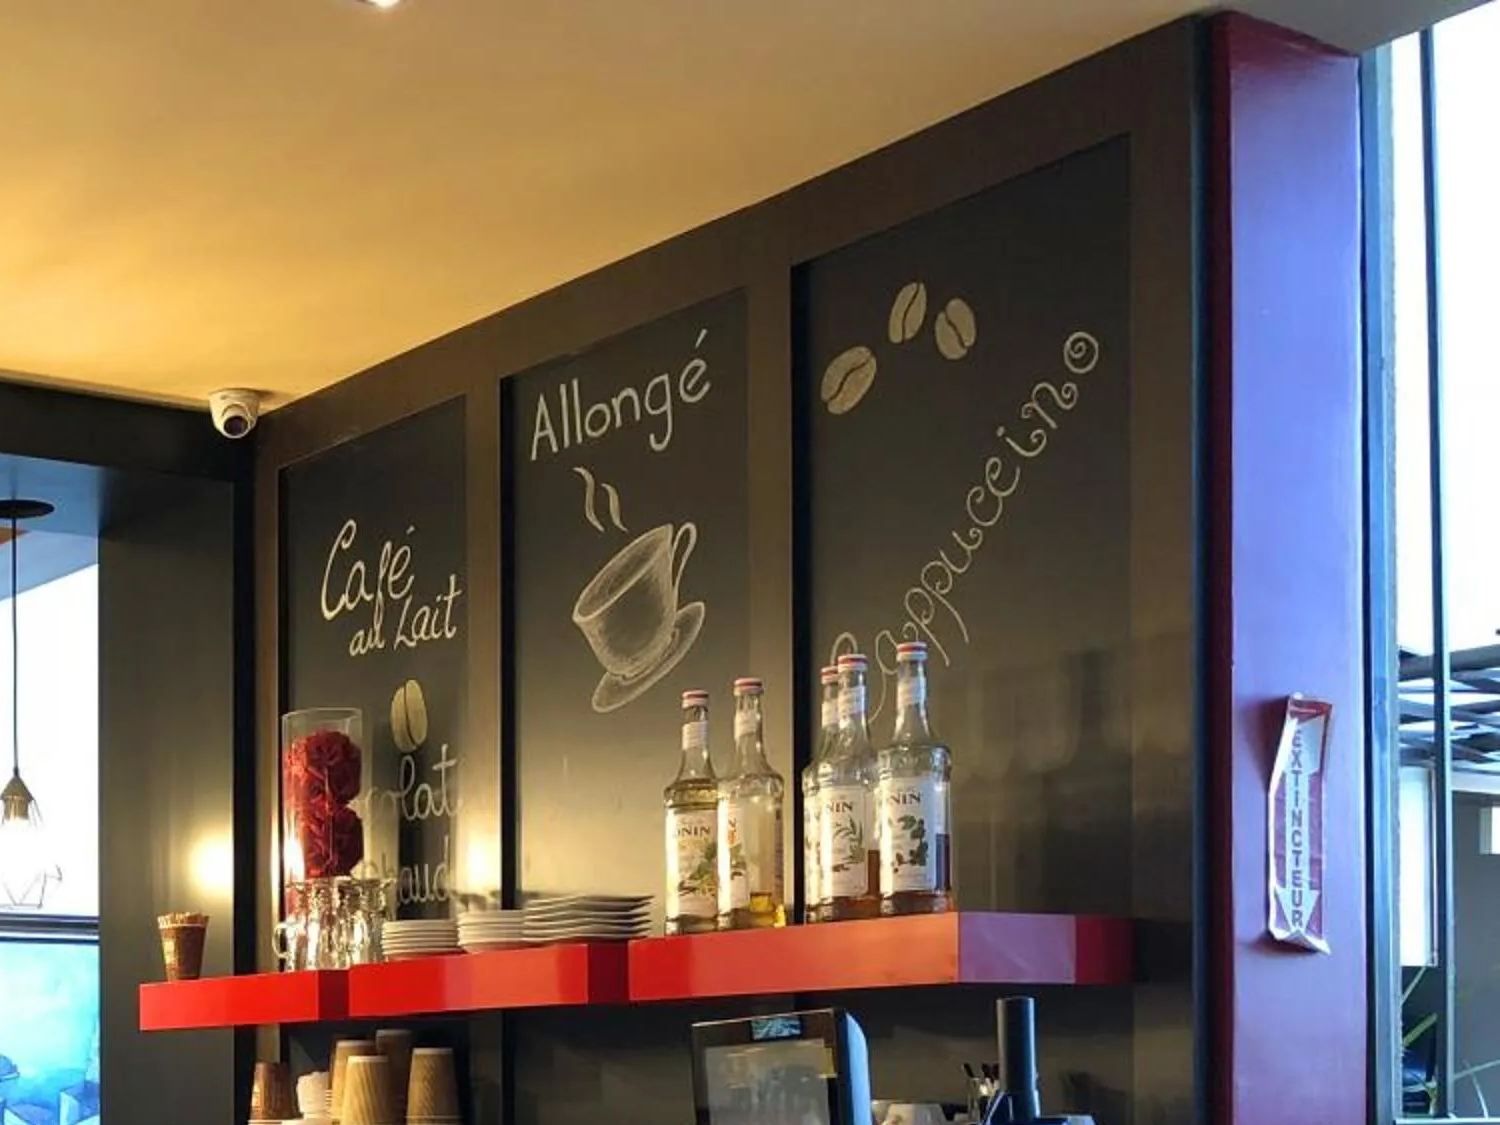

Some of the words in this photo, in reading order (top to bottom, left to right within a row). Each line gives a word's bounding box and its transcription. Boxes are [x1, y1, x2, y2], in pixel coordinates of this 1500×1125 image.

[530, 328, 711, 461] Allongé
[321, 518, 416, 621] Café
[394, 574, 463, 652] Lait
[1290, 730, 1303, 927] EXTINCTEUR
